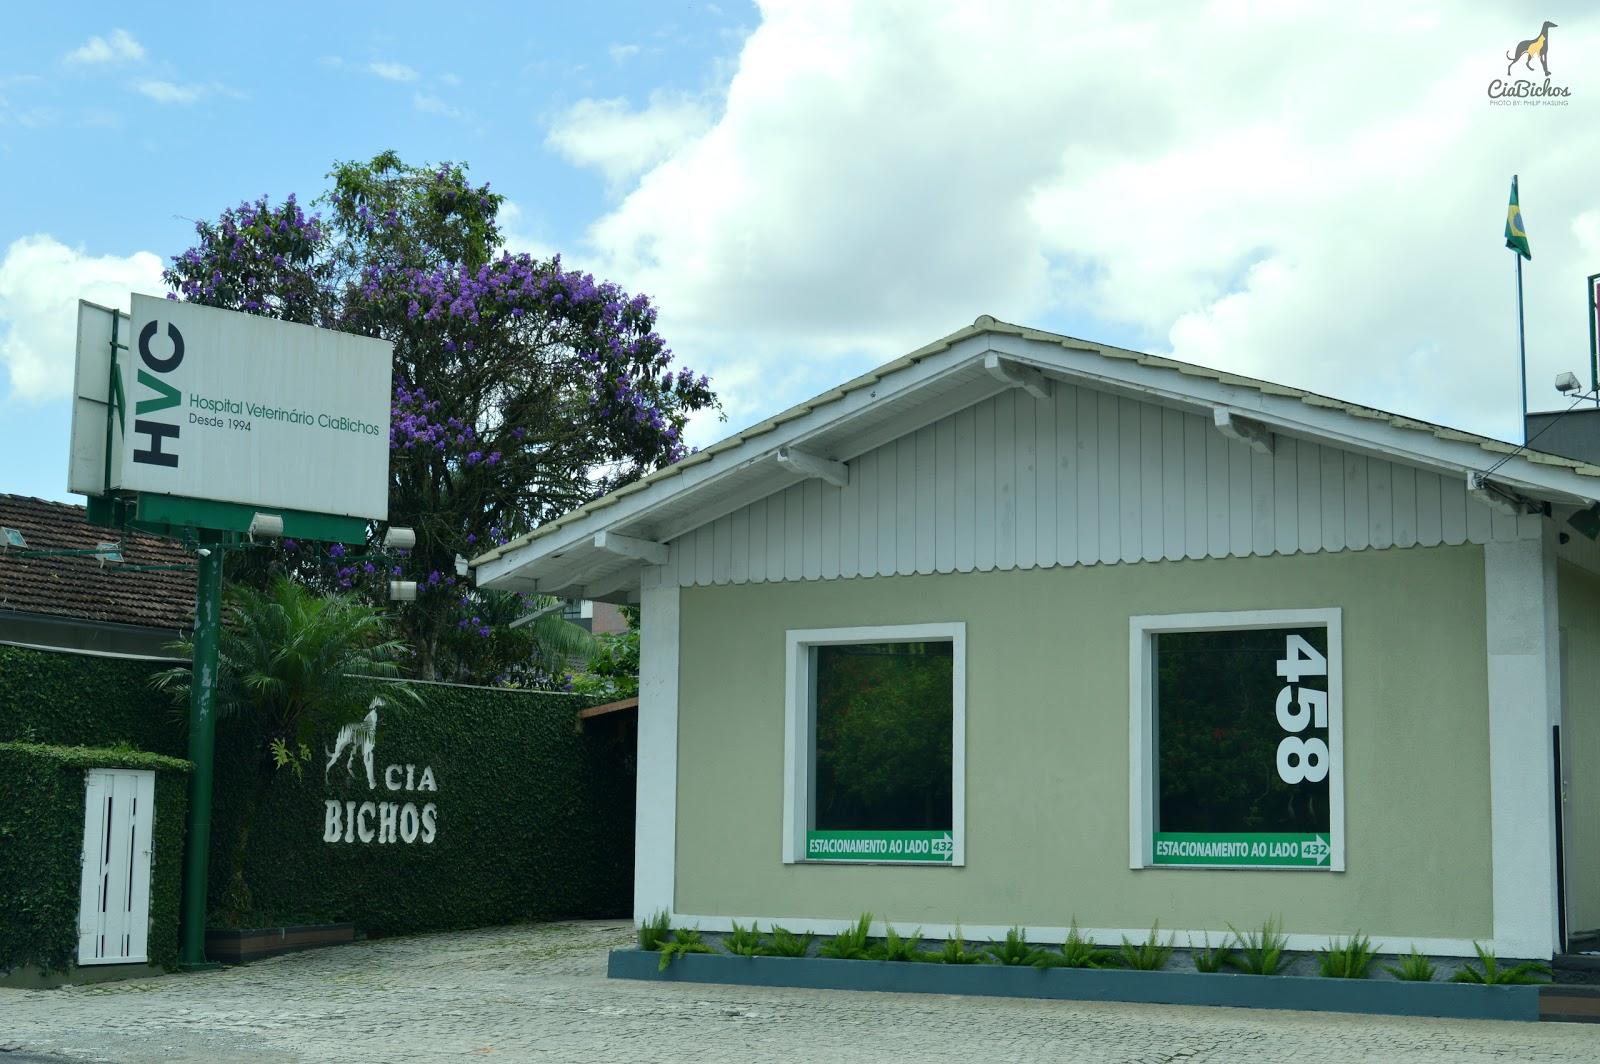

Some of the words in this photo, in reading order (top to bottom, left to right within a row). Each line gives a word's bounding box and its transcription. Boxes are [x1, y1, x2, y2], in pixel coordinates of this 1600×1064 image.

[133, 319, 185, 468] HVC
[189, 393, 243, 415] Hospital
[246, 403, 314, 426] Veterinário
[318, 413, 380, 436] CiaBichos
[189, 413, 224, 429] Desde
[228, 417, 252, 432] 1994
[1276, 635, 1329, 784] 458
[385, 764, 438, 791] CIA
[323, 800, 438, 844] BICHOS
[809, 839, 887, 853] ESTACIONAMENTO
[889, 839, 902, 853] AO
[904, 840, 929, 854] LADO
[933, 841, 953, 852] 432
[1156, 841, 1249, 857] ESTACIONAMENTO
[1251, 842, 1266, 857] AO
[1269, 842, 1298, 857] LADO
[1303, 844, 1327, 855] 432
